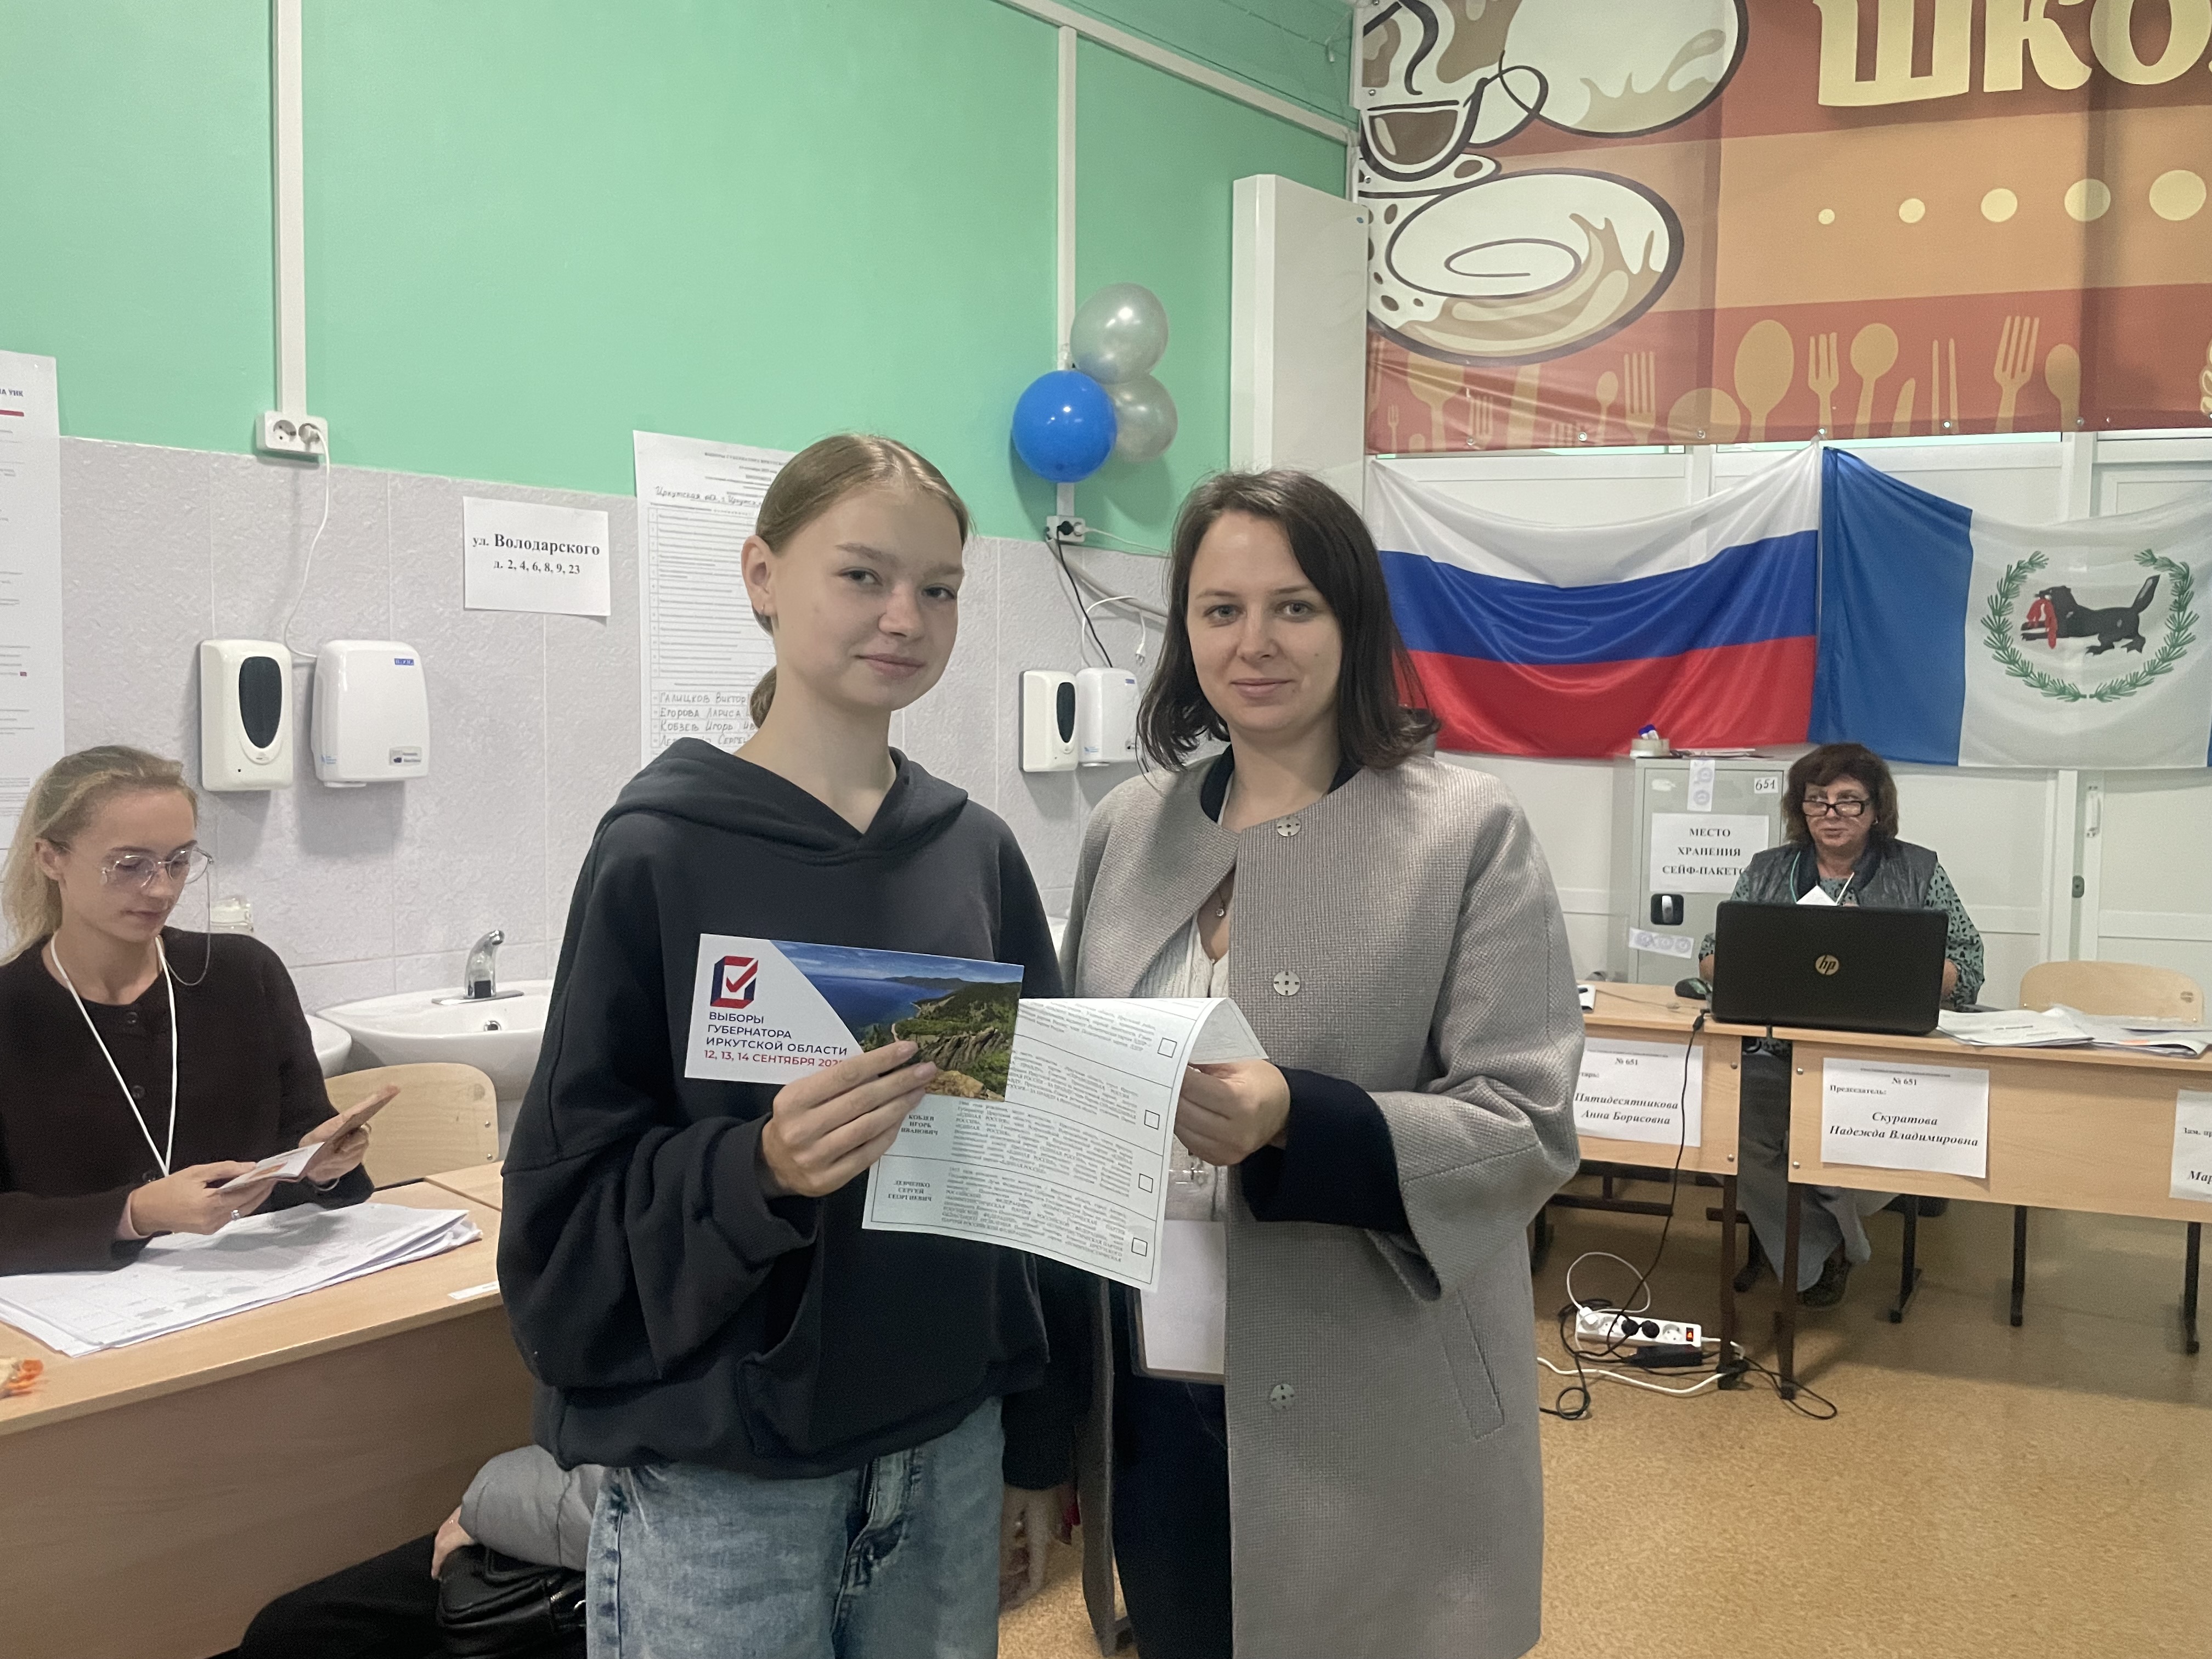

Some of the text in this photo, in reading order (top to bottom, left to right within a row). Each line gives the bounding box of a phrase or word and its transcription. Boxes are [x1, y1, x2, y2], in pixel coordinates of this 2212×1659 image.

[1815, 0, 2212, 106] ШКО
[472, 533, 600, 555] ул. Володарского
[494, 560, 580, 574] д. 2, 4, 6, 8, 9, 23
[1755, 779, 1776, 791] 651
[1689, 828, 1731, 837] МЕСТО
[1677, 847, 1741, 856] ХРАНЕНИЯ
[1662, 865, 1746, 876] СЕЙФ-ПАКЕТО
[1819, 955, 1837, 974] hp
[709, 1011, 764, 1024] ВЫБОРЫ
[707, 1024, 792, 1039] ГУБЕРНАТОРА
[706, 1036, 848, 1056] ИРКУТСКОЙ ОБЛАСТИ
[704, 1049, 843, 1067] 12, 13, 14 СЕНТЯБРЯ 202
[1575, 1093, 1678, 1109] Пятидесятникова
[1581, 1110, 1671, 1124] Анна Борисовна
[1872, 1111, 1938, 1125] Скуратова
[1830, 1126, 1979, 1147] Надежда Владимировна
[2188, 1170, 2212, 1184] Мар
